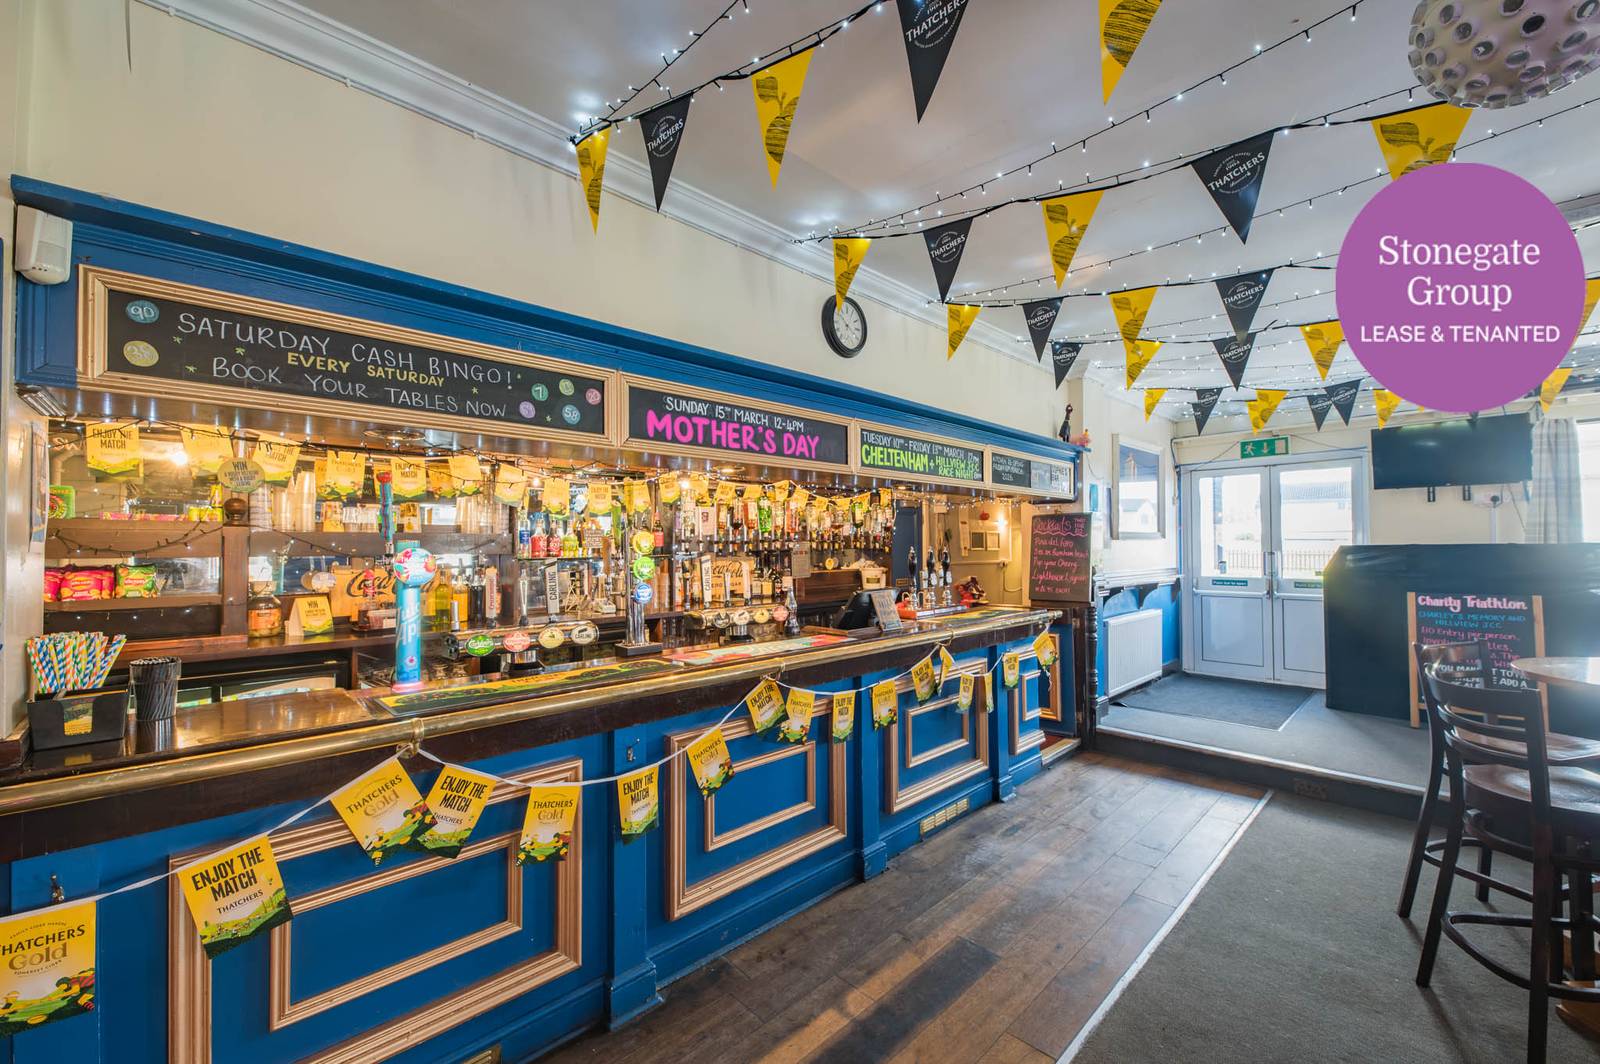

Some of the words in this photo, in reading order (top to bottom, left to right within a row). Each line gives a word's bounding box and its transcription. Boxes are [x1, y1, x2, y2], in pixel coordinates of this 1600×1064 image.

[647, 118, 684, 151] THATCHERS
[1208, 152, 1265, 190] THATCHERS
[931, 234, 966, 258] THATCHERS
[1223, 284, 1265, 305] THATCHERS
[177, 312, 331, 356] SATURDAY
[351, 342, 414, 371] CASH
[429, 356, 513, 390] BINGO!
[287, 352, 350, 374] EVERY
[367, 364, 445, 388] SATURDAY
[212, 356, 283, 384] BOOK
[303, 373, 370, 399] YOUR
[384, 386, 459, 414] TABLES
[466, 400, 507, 418] NOW
[665, 396, 710, 416] SUNDAY
[734, 408, 769, 427] MARCH
[773, 416, 805, 433] 12-4PM
[100, 439, 126, 449] MATCH
[646, 409, 777, 454] MOTHER'S
[783, 432, 820, 460] DAY
[862, 431, 892, 447] TUESDAY
[908, 440, 931, 455] FRIDAY
[943, 446, 965, 460] MARCH
[861, 444, 929, 473] CHELTENHAM
[548, 571, 557, 601] CARLING
[1418, 595, 1461, 613] Charity
[750, 690, 765, 708] ENJOY
[763, 683, 775, 694] THE
[757, 694, 773, 712] MATCH
[693, 738, 722, 762] THATCHERS
[346, 774, 403, 814] THATCHERS
[440, 775, 470, 795] ENJOY
[469, 782, 488, 800] THE
[623, 778, 644, 796] ENJOY
[644, 771, 655, 785] THE
[630, 788, 650, 806] MATCH
[363, 789, 400, 816] Gold
[439, 792, 473, 814] MATCH
[533, 799, 574, 809] THATCHERS
[537, 808, 565, 821] Gold
[433, 812, 464, 825] THATCHERS
[191, 860, 236, 892] ENJOY
[237, 846, 265, 870] THE
[211, 868, 258, 902] MATCH
[216, 888, 265, 915] THATCHERS
[0, 924, 86, 956] HATCHERS
[8, 942, 68, 971] Gold
